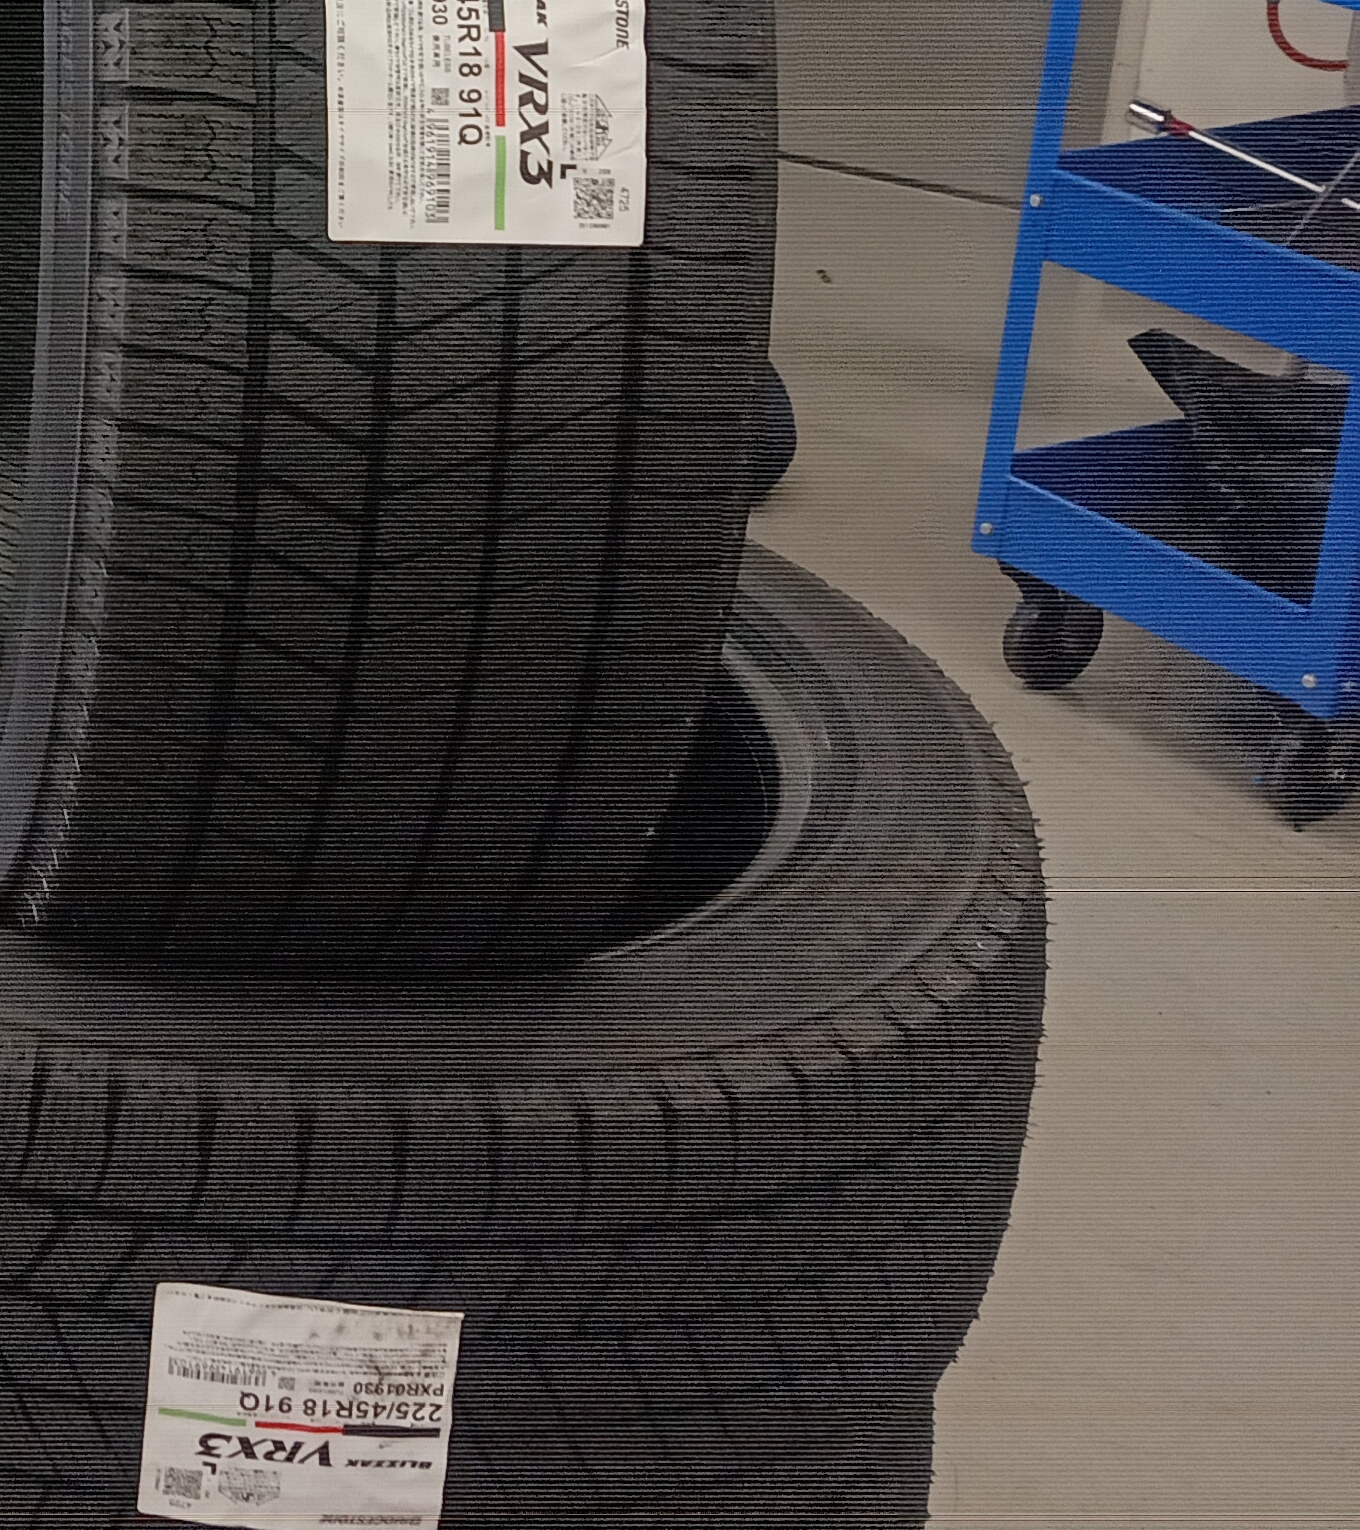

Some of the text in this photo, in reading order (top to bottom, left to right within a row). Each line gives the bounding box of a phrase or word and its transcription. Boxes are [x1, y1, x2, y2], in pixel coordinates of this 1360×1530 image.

[458, 88, 483, 146] 91Q
[512, 38, 554, 189] VRX3
[618, 187, 630, 212] 4725
[239, 1390, 443, 1422] 225/45R18 91Q
[353, 1382, 445, 1397] PXR01930
[194, 1433, 433, 1470] BLIZZAK VRX3
